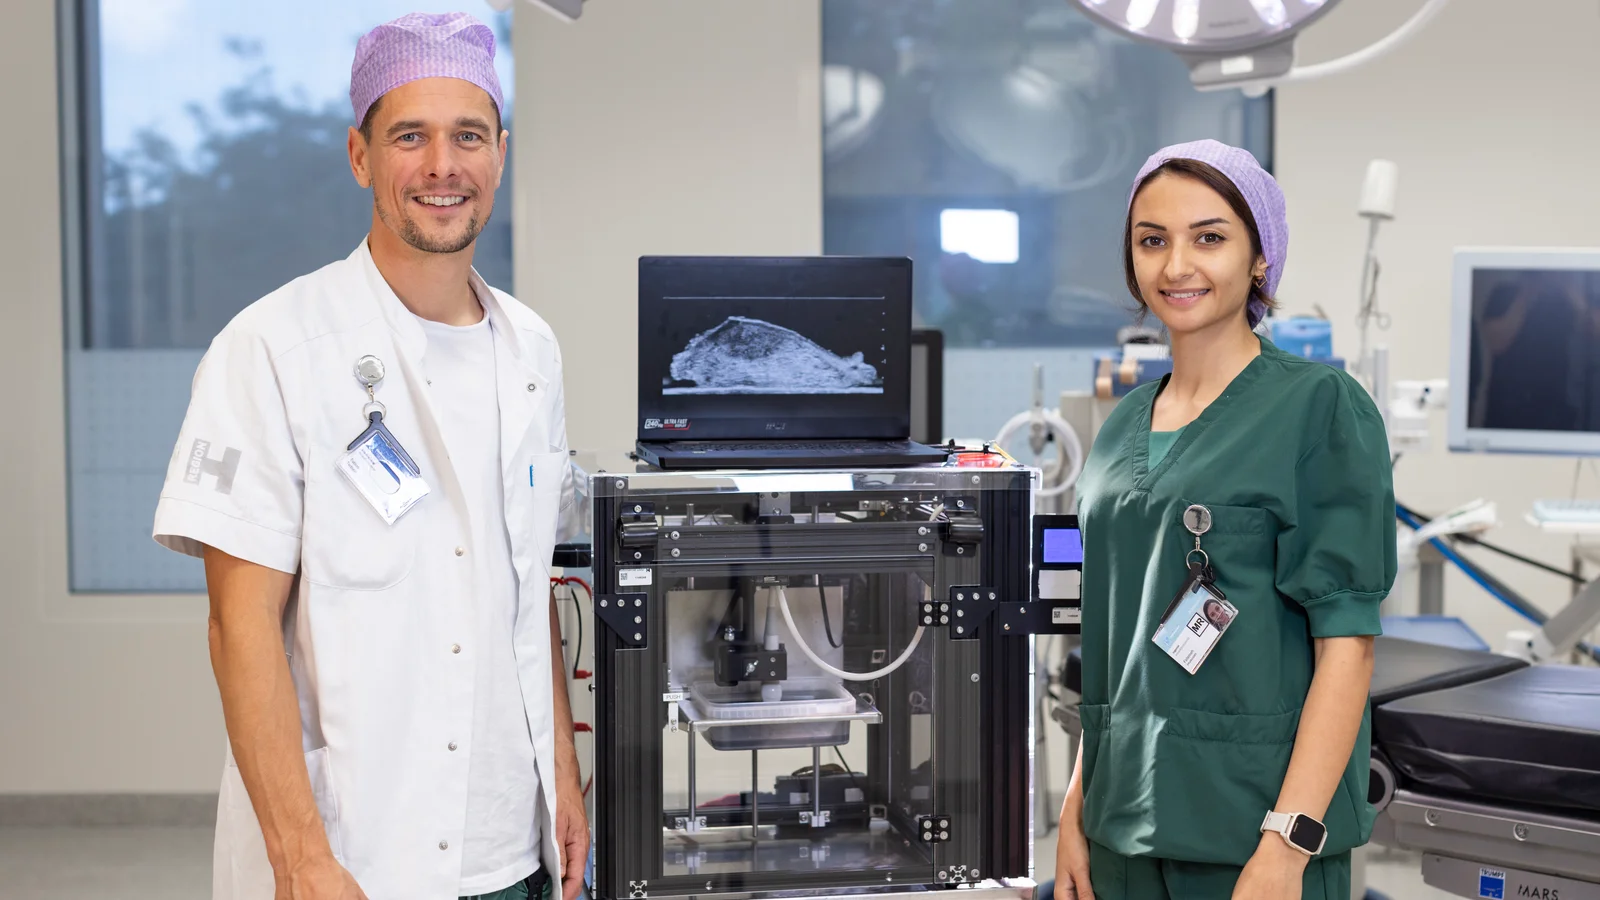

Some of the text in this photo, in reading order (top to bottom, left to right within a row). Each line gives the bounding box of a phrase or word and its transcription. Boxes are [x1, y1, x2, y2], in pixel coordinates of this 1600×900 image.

[186, 440, 208, 482] REGION
[1191, 617, 1205, 632] MR
[1517, 883, 1559, 900] MARS
